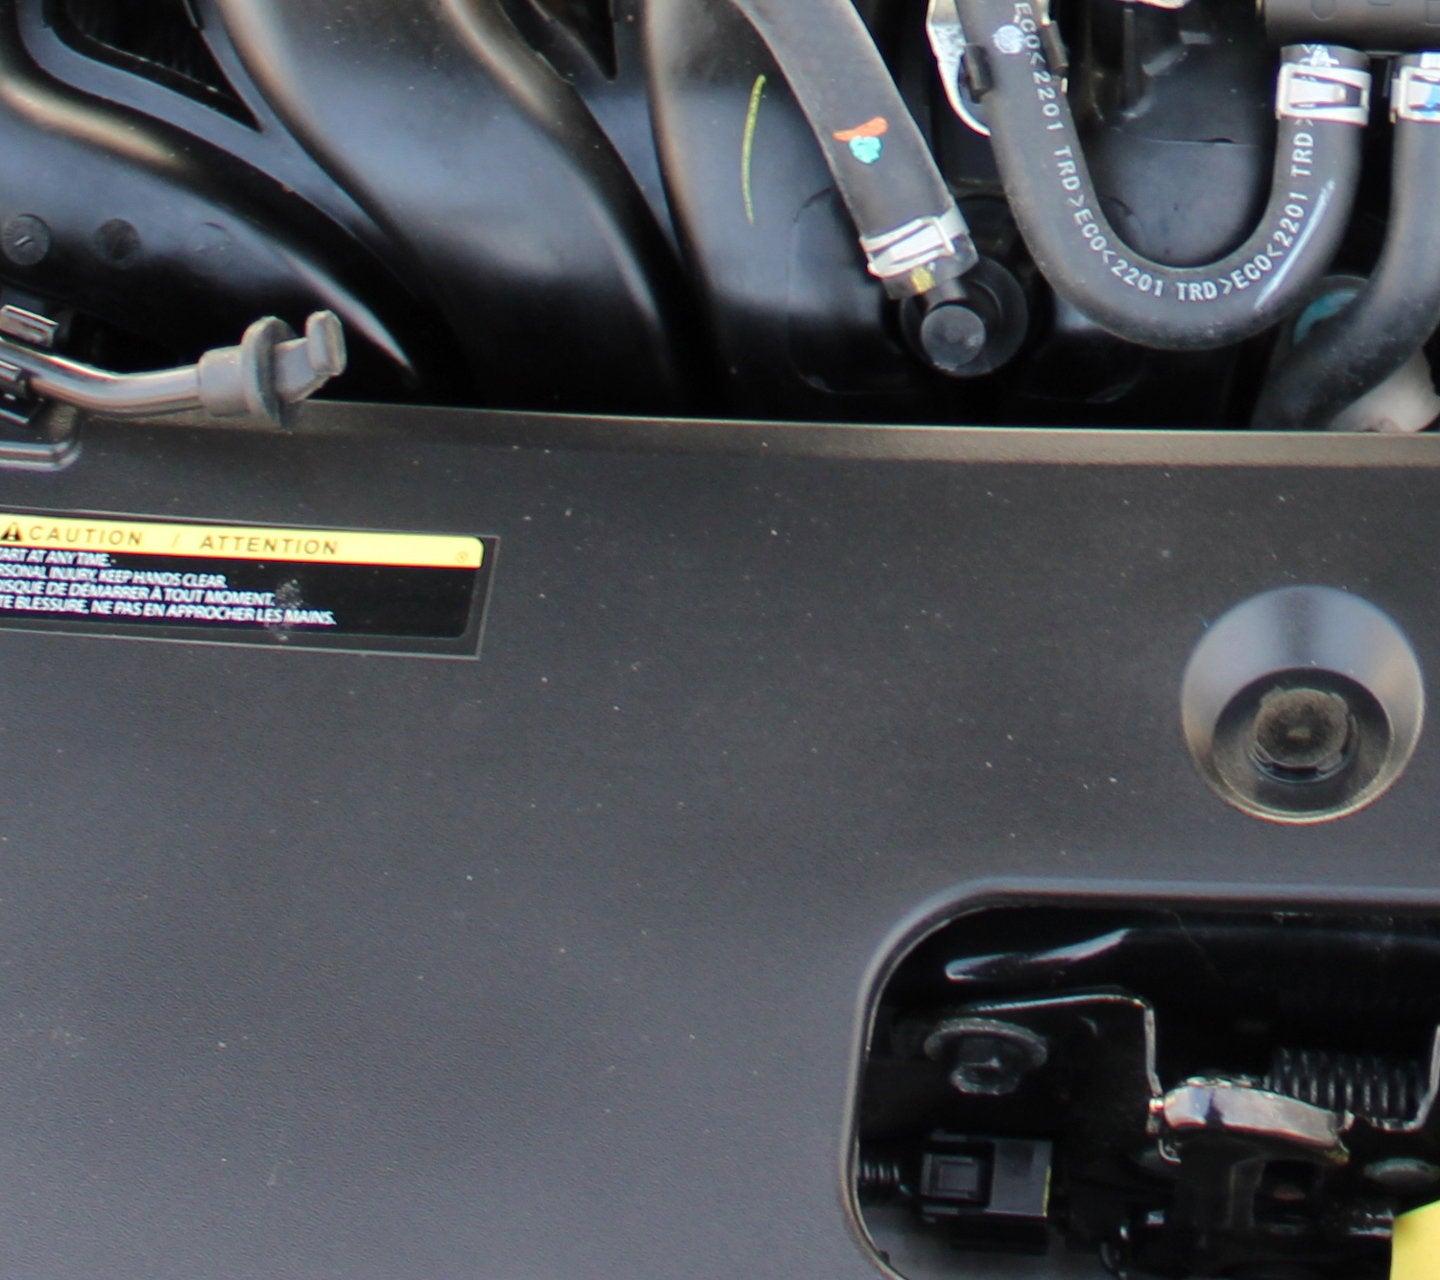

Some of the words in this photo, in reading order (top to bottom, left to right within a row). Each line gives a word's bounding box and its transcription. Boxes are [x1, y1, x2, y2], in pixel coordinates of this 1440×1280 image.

[28, 525, 143, 547] CAUTION
[200, 535, 338, 556] ATTENTION
[26, 548, 47, 563] AT
[46, 550, 76, 565] ANY
[75, 552, 110, 567] TIME.
[98, 568, 134, 584] KEEP
[132, 571, 182, 586] HANDS
[182, 573, 228, 589] CLEAR.
[45, 581, 68, 596] DE
[68, 581, 150, 600] DÉMARRER
[163, 589, 206, 604] TOUT
[205, 590, 276, 607] MOMENT.
[14, 596, 90, 615] BLESSURE,
[90, 599, 113, 615] NE
[113, 601, 144, 616] PAS
[143, 603, 166, 618] EN
[165, 604, 256, 622] APPROCHER
[255, 607, 283, 623] LES
[282, 609, 337, 626] MAINS.
